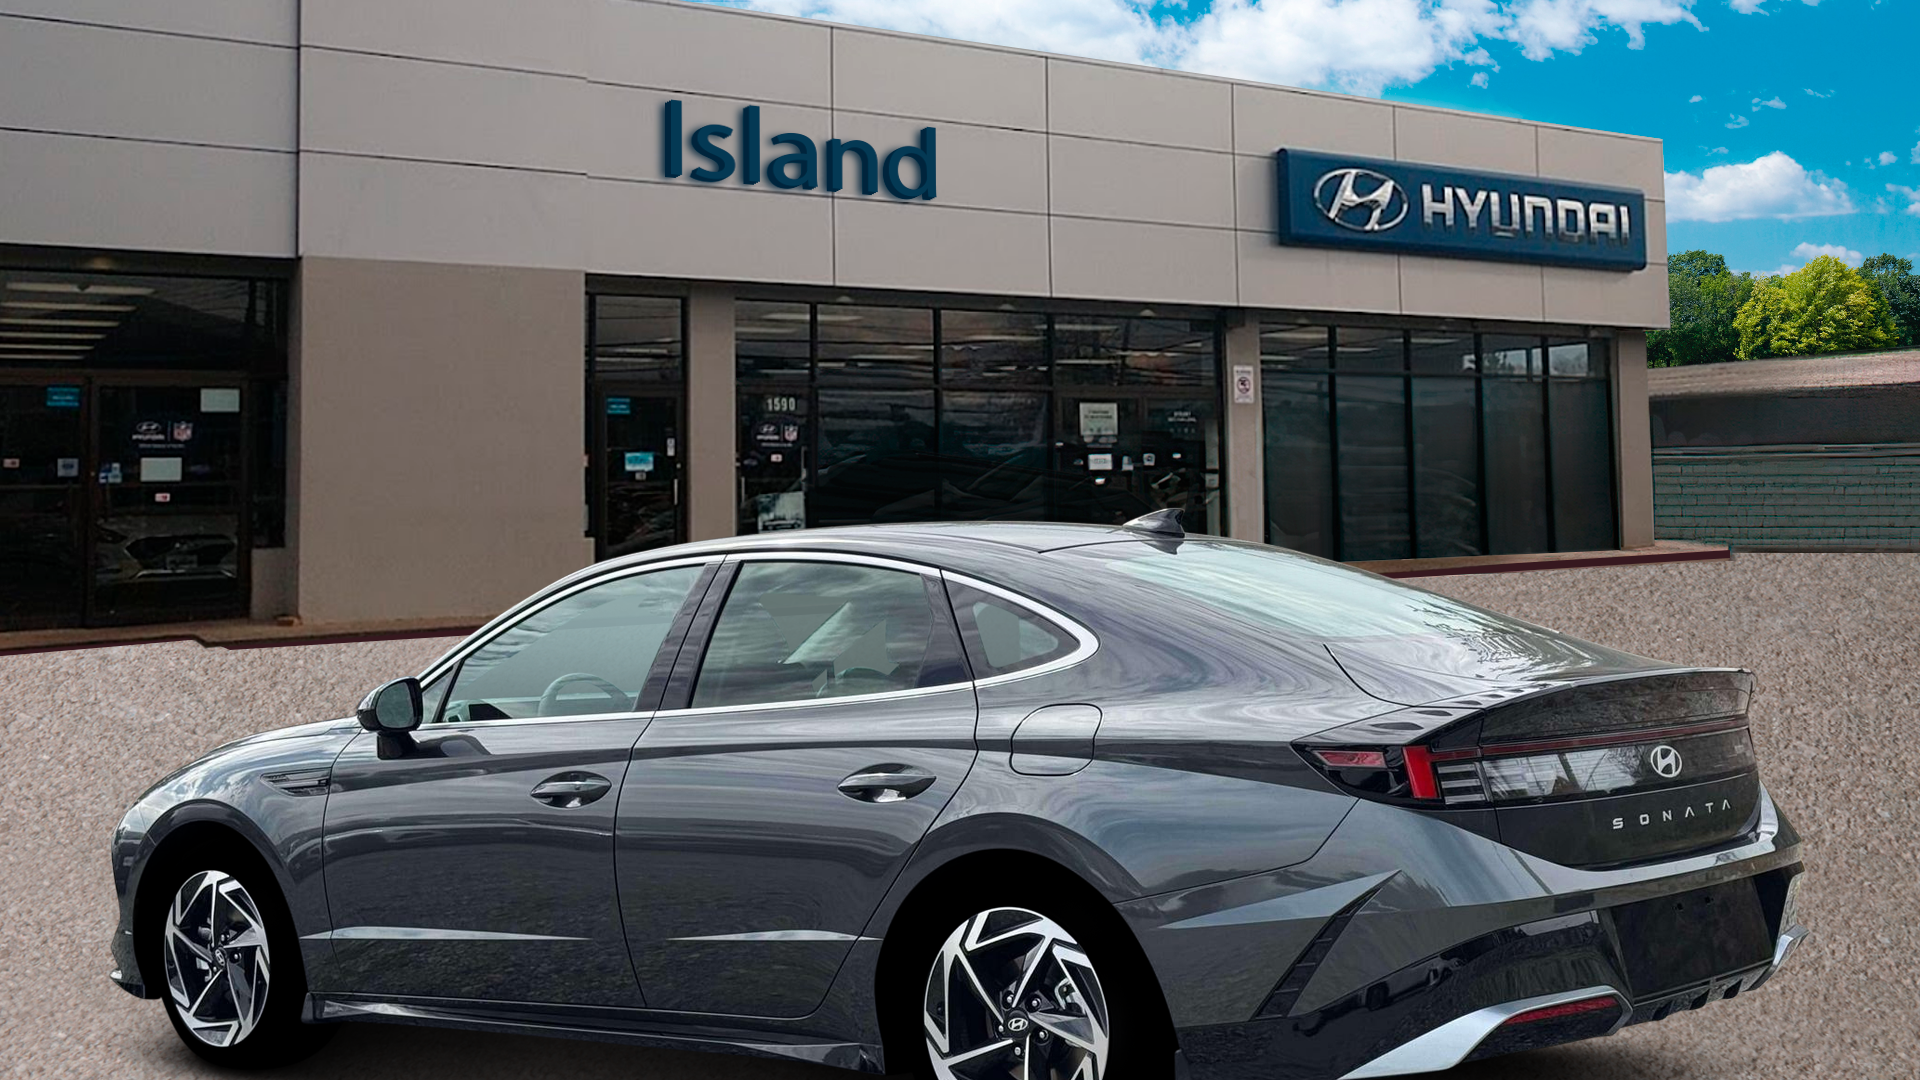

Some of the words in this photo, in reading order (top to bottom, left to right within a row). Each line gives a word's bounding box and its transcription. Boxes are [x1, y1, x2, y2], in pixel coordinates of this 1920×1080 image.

[664, 99, 937, 201] Island
[1421, 184, 1630, 245] HYUNDAI
[766, 396, 796, 411] 1590
[1612, 798, 1731, 830] SONATA
